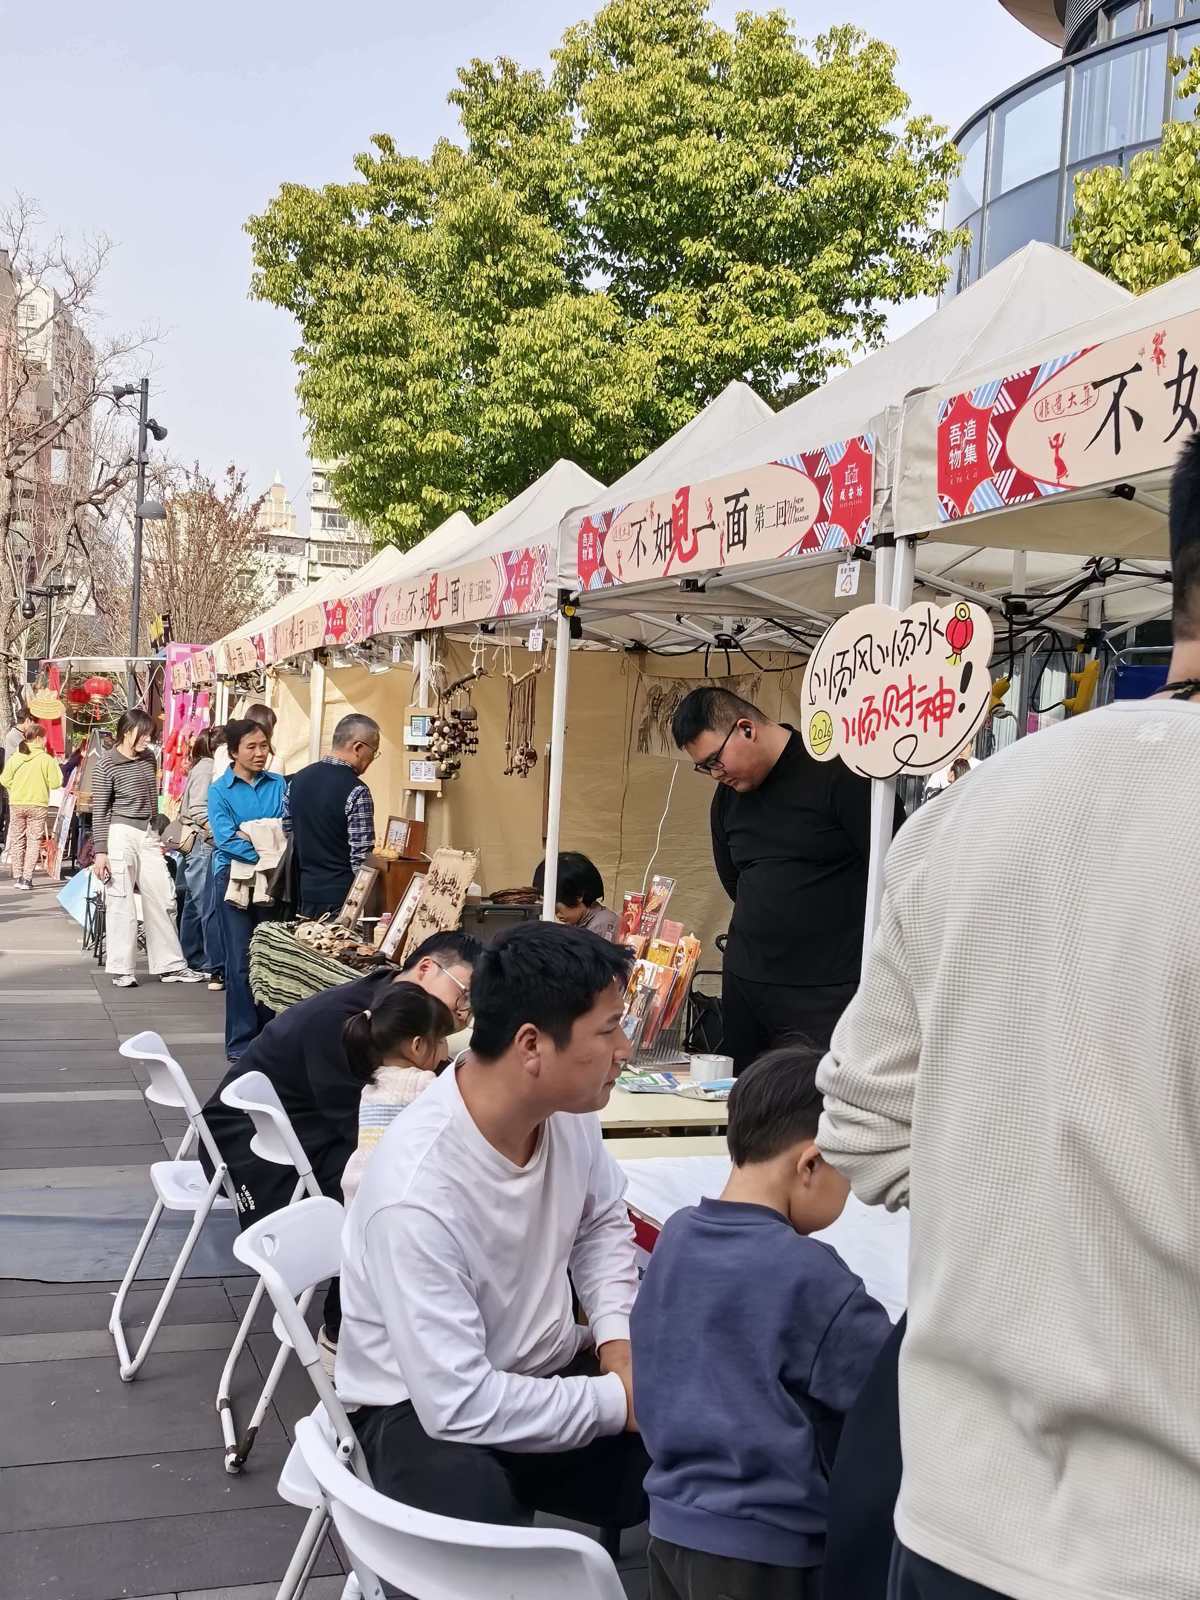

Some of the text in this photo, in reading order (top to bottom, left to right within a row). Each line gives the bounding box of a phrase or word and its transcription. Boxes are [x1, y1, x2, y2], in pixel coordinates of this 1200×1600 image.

[815, 607, 945, 705] 顺风顺水
[812, 719, 832, 742] 2026
